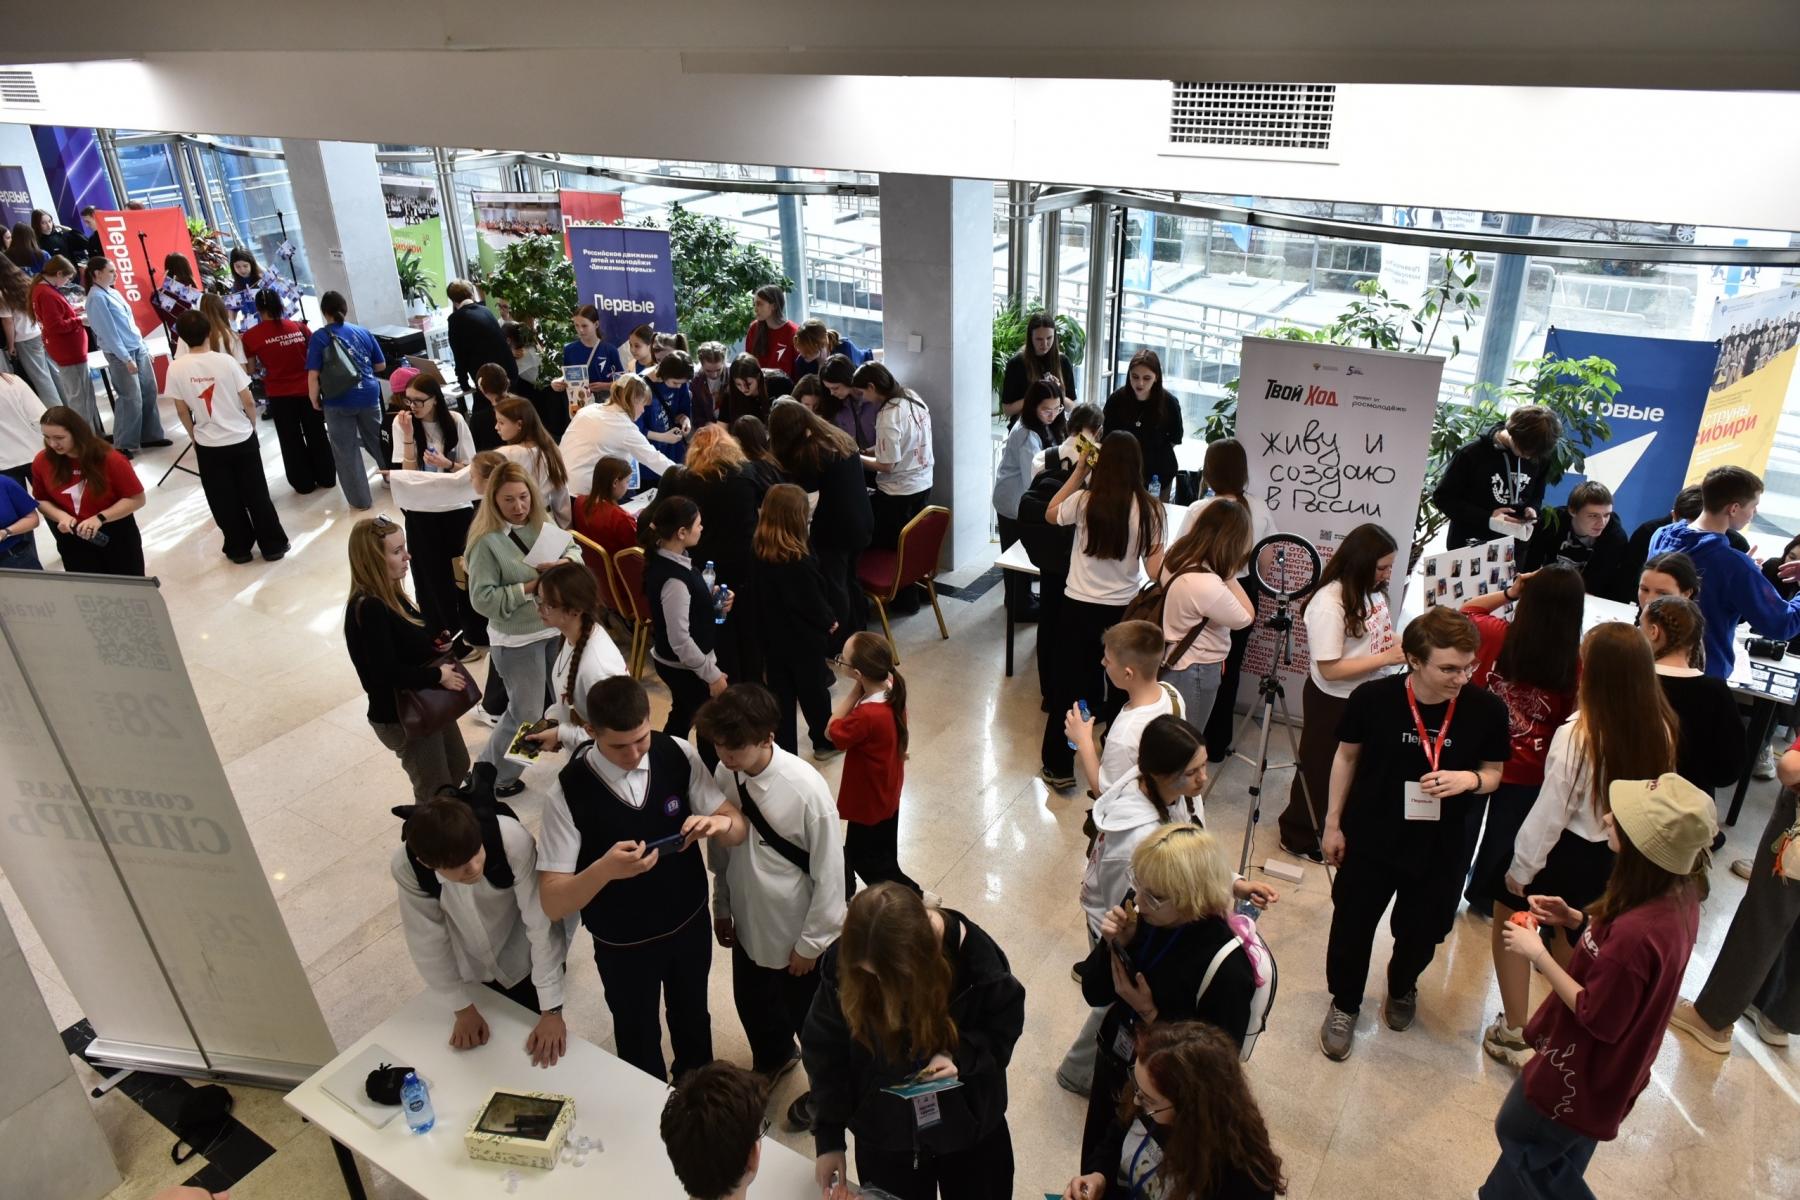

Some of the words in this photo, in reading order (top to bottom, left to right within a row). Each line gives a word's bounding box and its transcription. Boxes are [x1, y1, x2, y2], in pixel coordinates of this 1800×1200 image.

[0, 190, 30, 207] ервые
[104, 216, 142, 303] Первые
[594, 294, 655, 316] Первые
[1270, 465, 1396, 499] создаю
[1293, 489, 1382, 517] России
